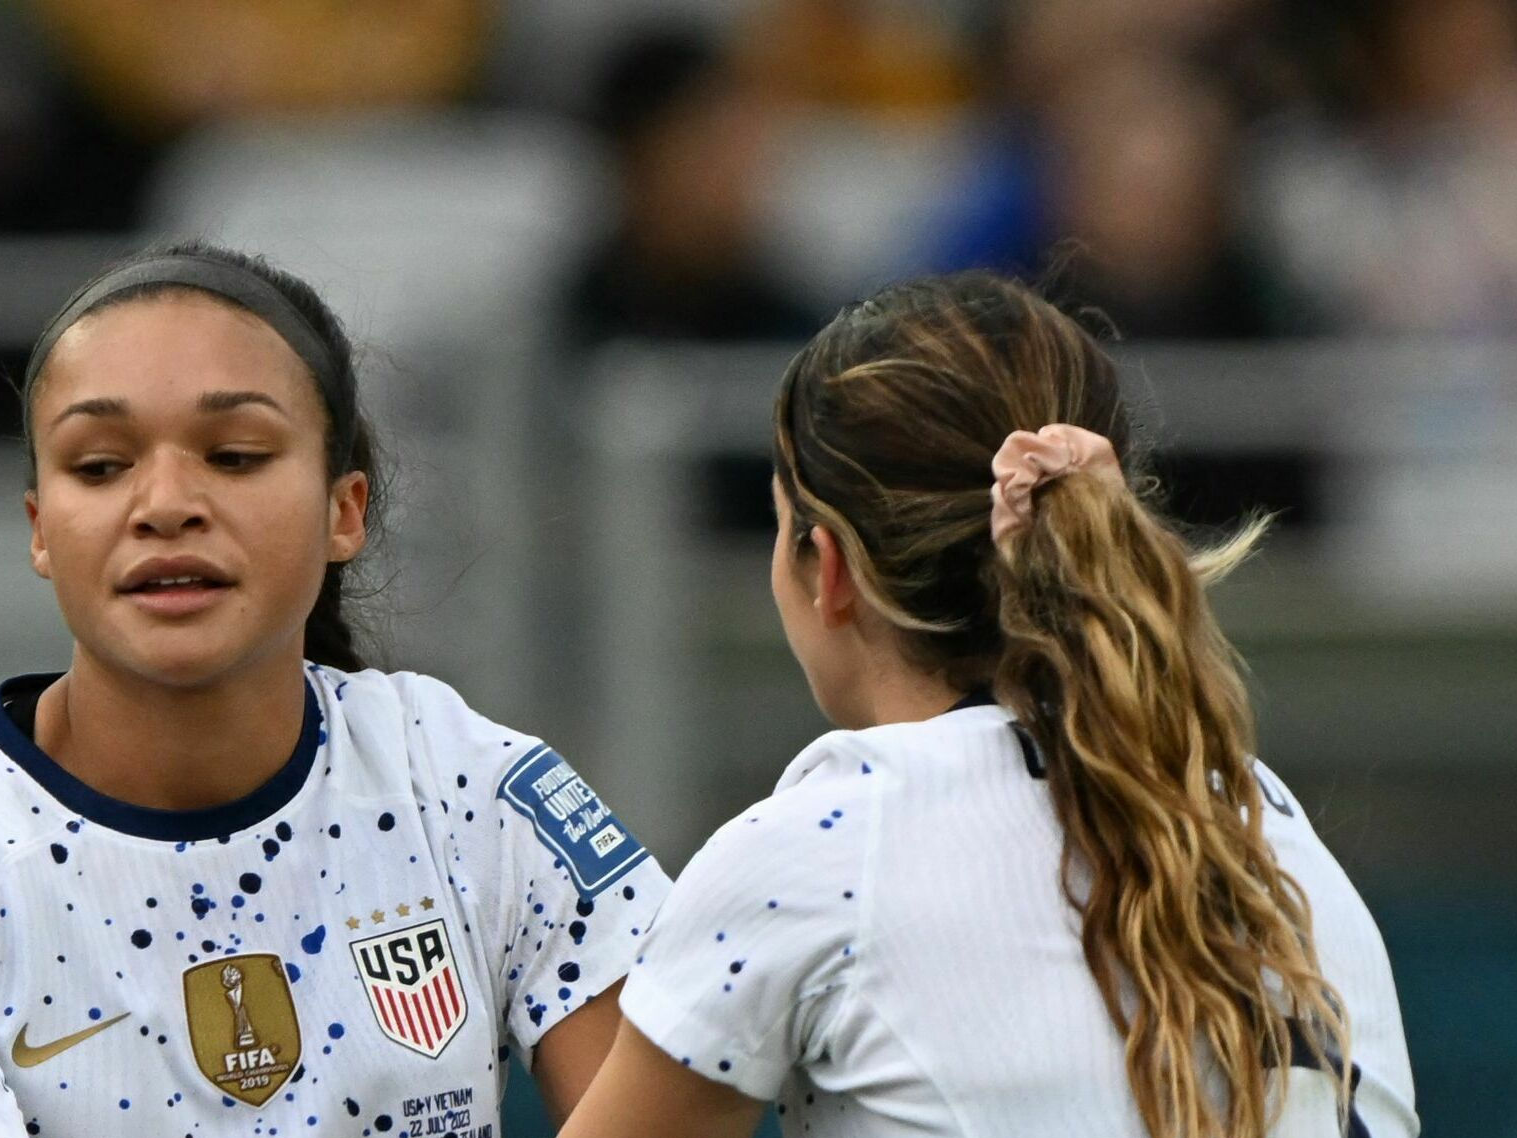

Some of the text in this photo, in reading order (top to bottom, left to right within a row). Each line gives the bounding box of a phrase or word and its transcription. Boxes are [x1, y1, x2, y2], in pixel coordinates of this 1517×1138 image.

[595, 833, 617, 850] FIFA
[359, 928, 447, 986] USA
[225, 1048, 276, 1072] FIFA
[240, 1074, 270, 1090] 2019
[434, 1087, 473, 1110] VIETNAM
[409, 1109, 471, 1138] 22 JULY 2023
